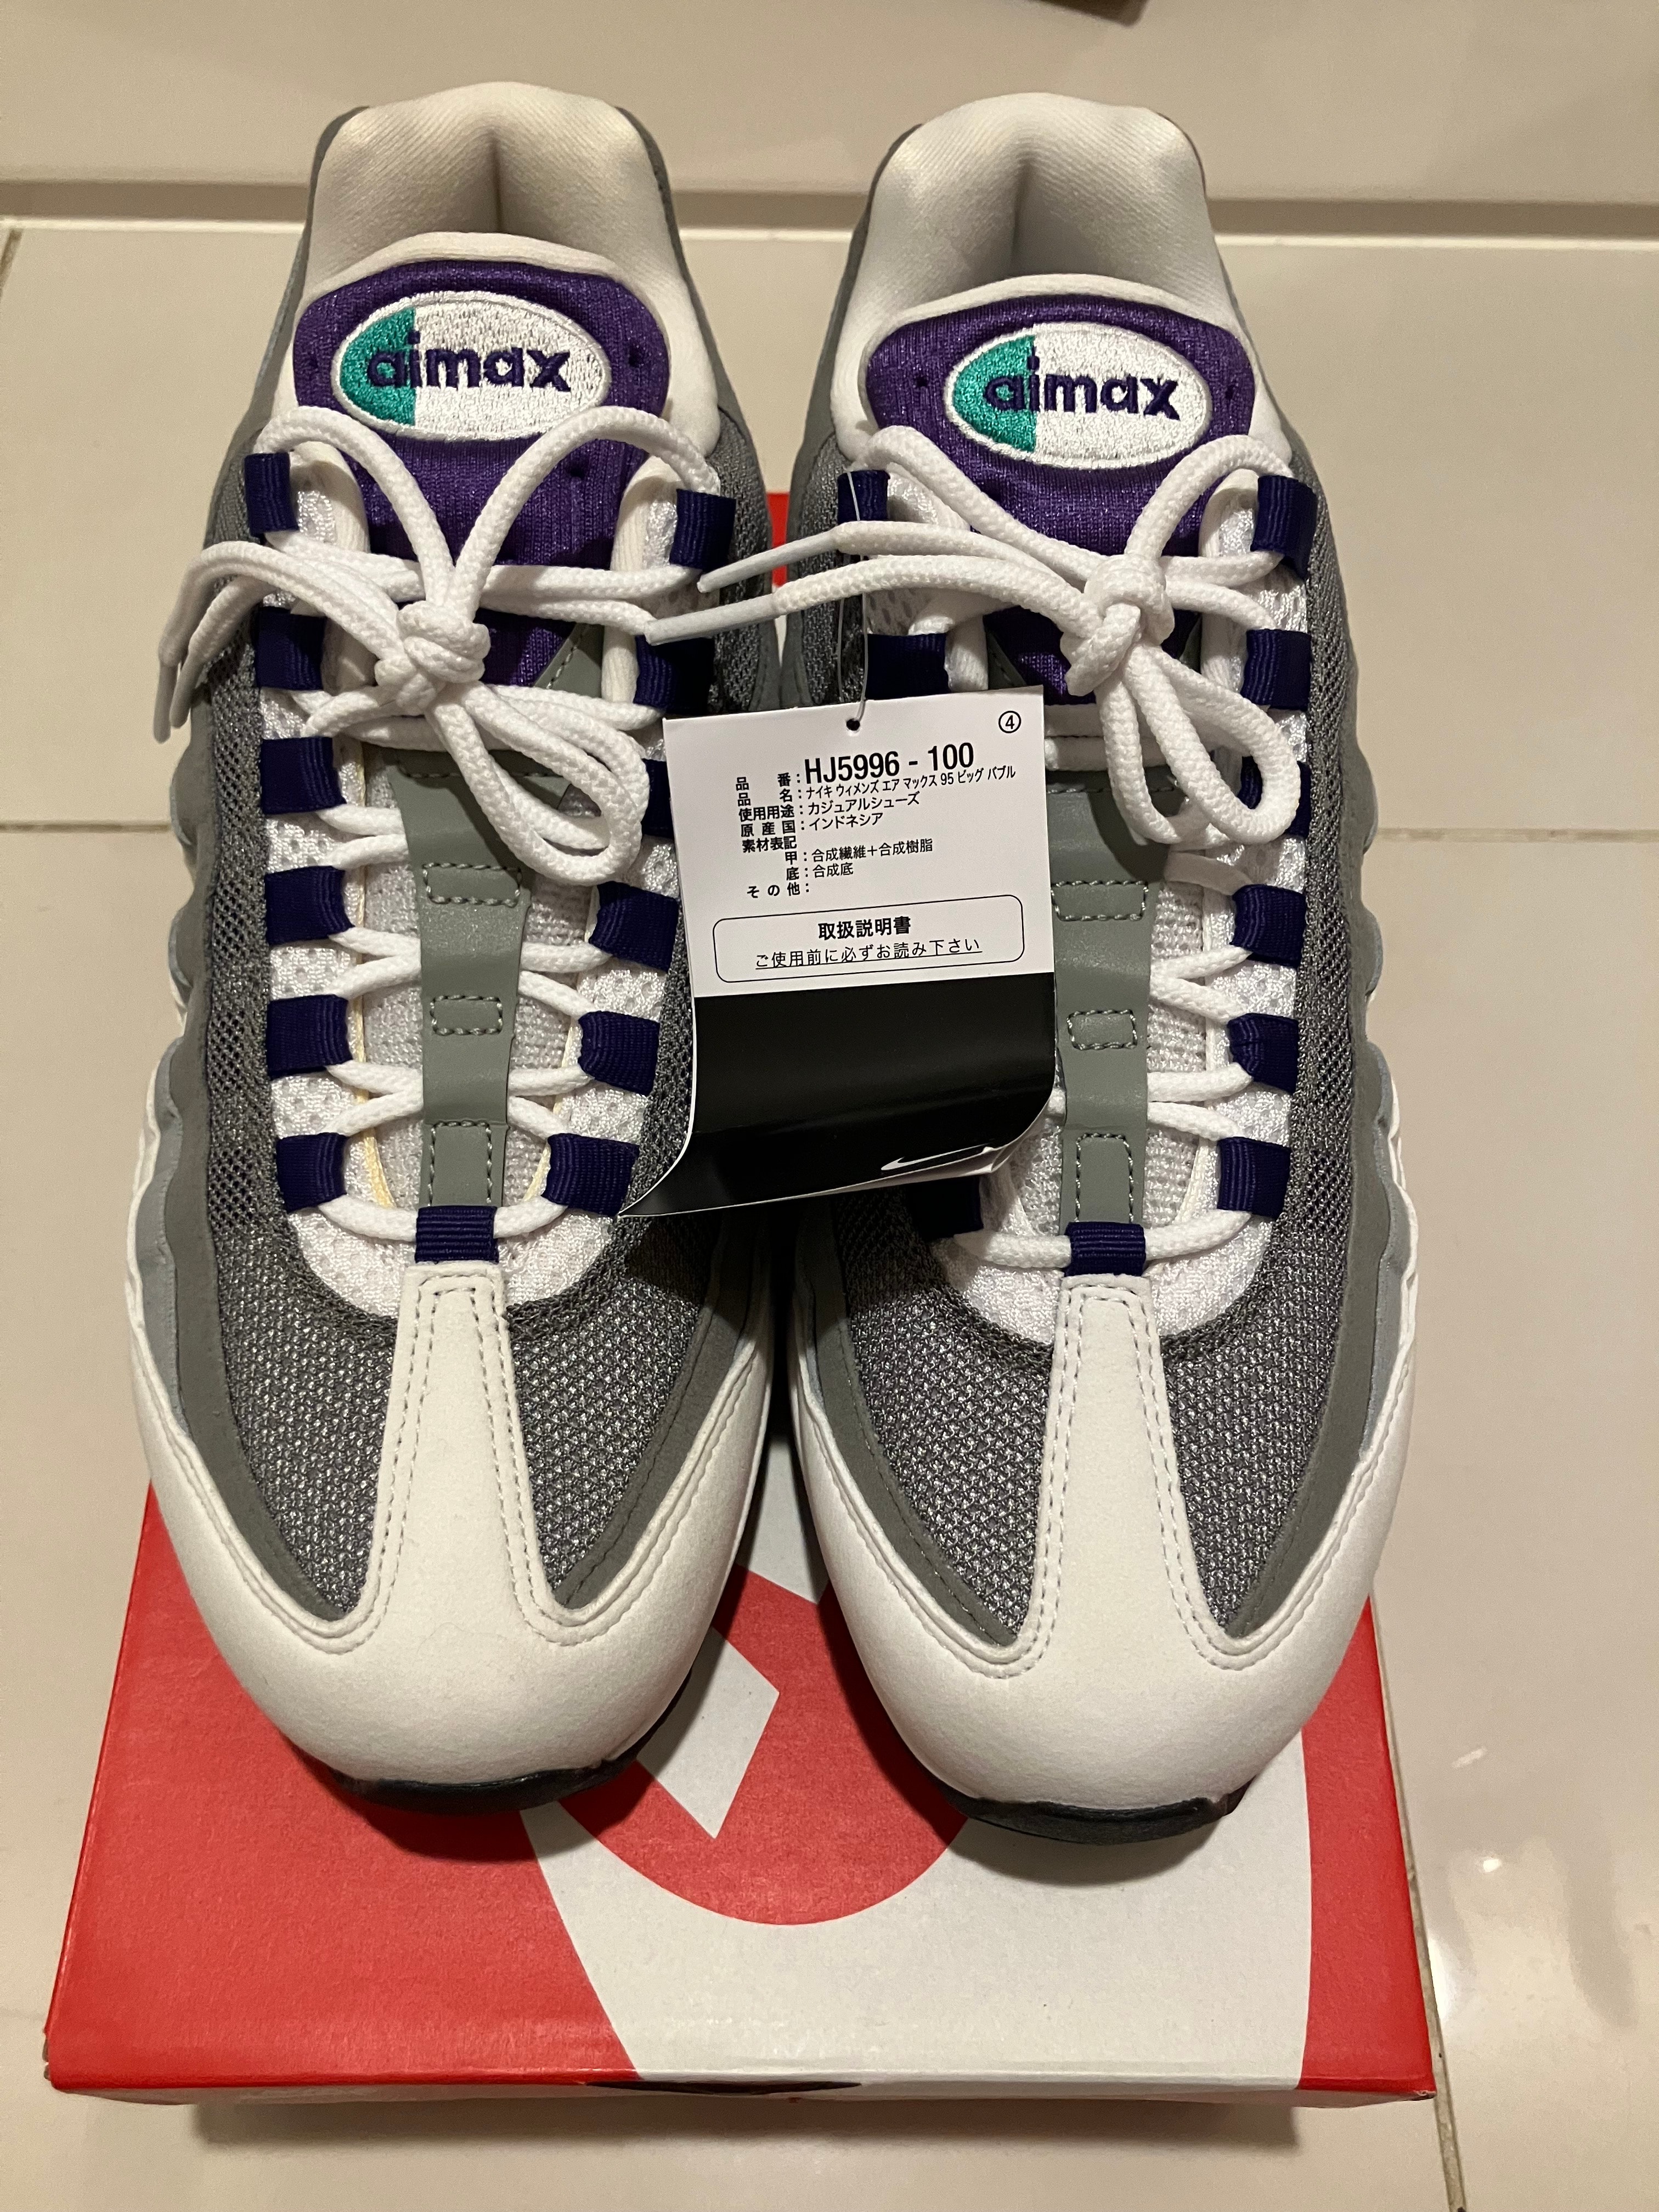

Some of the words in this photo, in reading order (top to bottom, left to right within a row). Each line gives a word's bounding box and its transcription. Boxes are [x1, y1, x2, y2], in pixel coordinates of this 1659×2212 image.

[805, 751, 900, 785] HJ5996
[928, 742, 974, 771] 100
[940, 772, 954, 786] 95
[808, 791, 921, 816] カジュアルシューズ
[809, 811, 884, 832] インドネシア
[742, 835, 797, 853] 素材表記
[812, 861, 854, 878] 合成底
[817, 916, 911, 941] 取扱説明書
[755, 938, 982, 969] ご使用前に必ずお読み下さい
